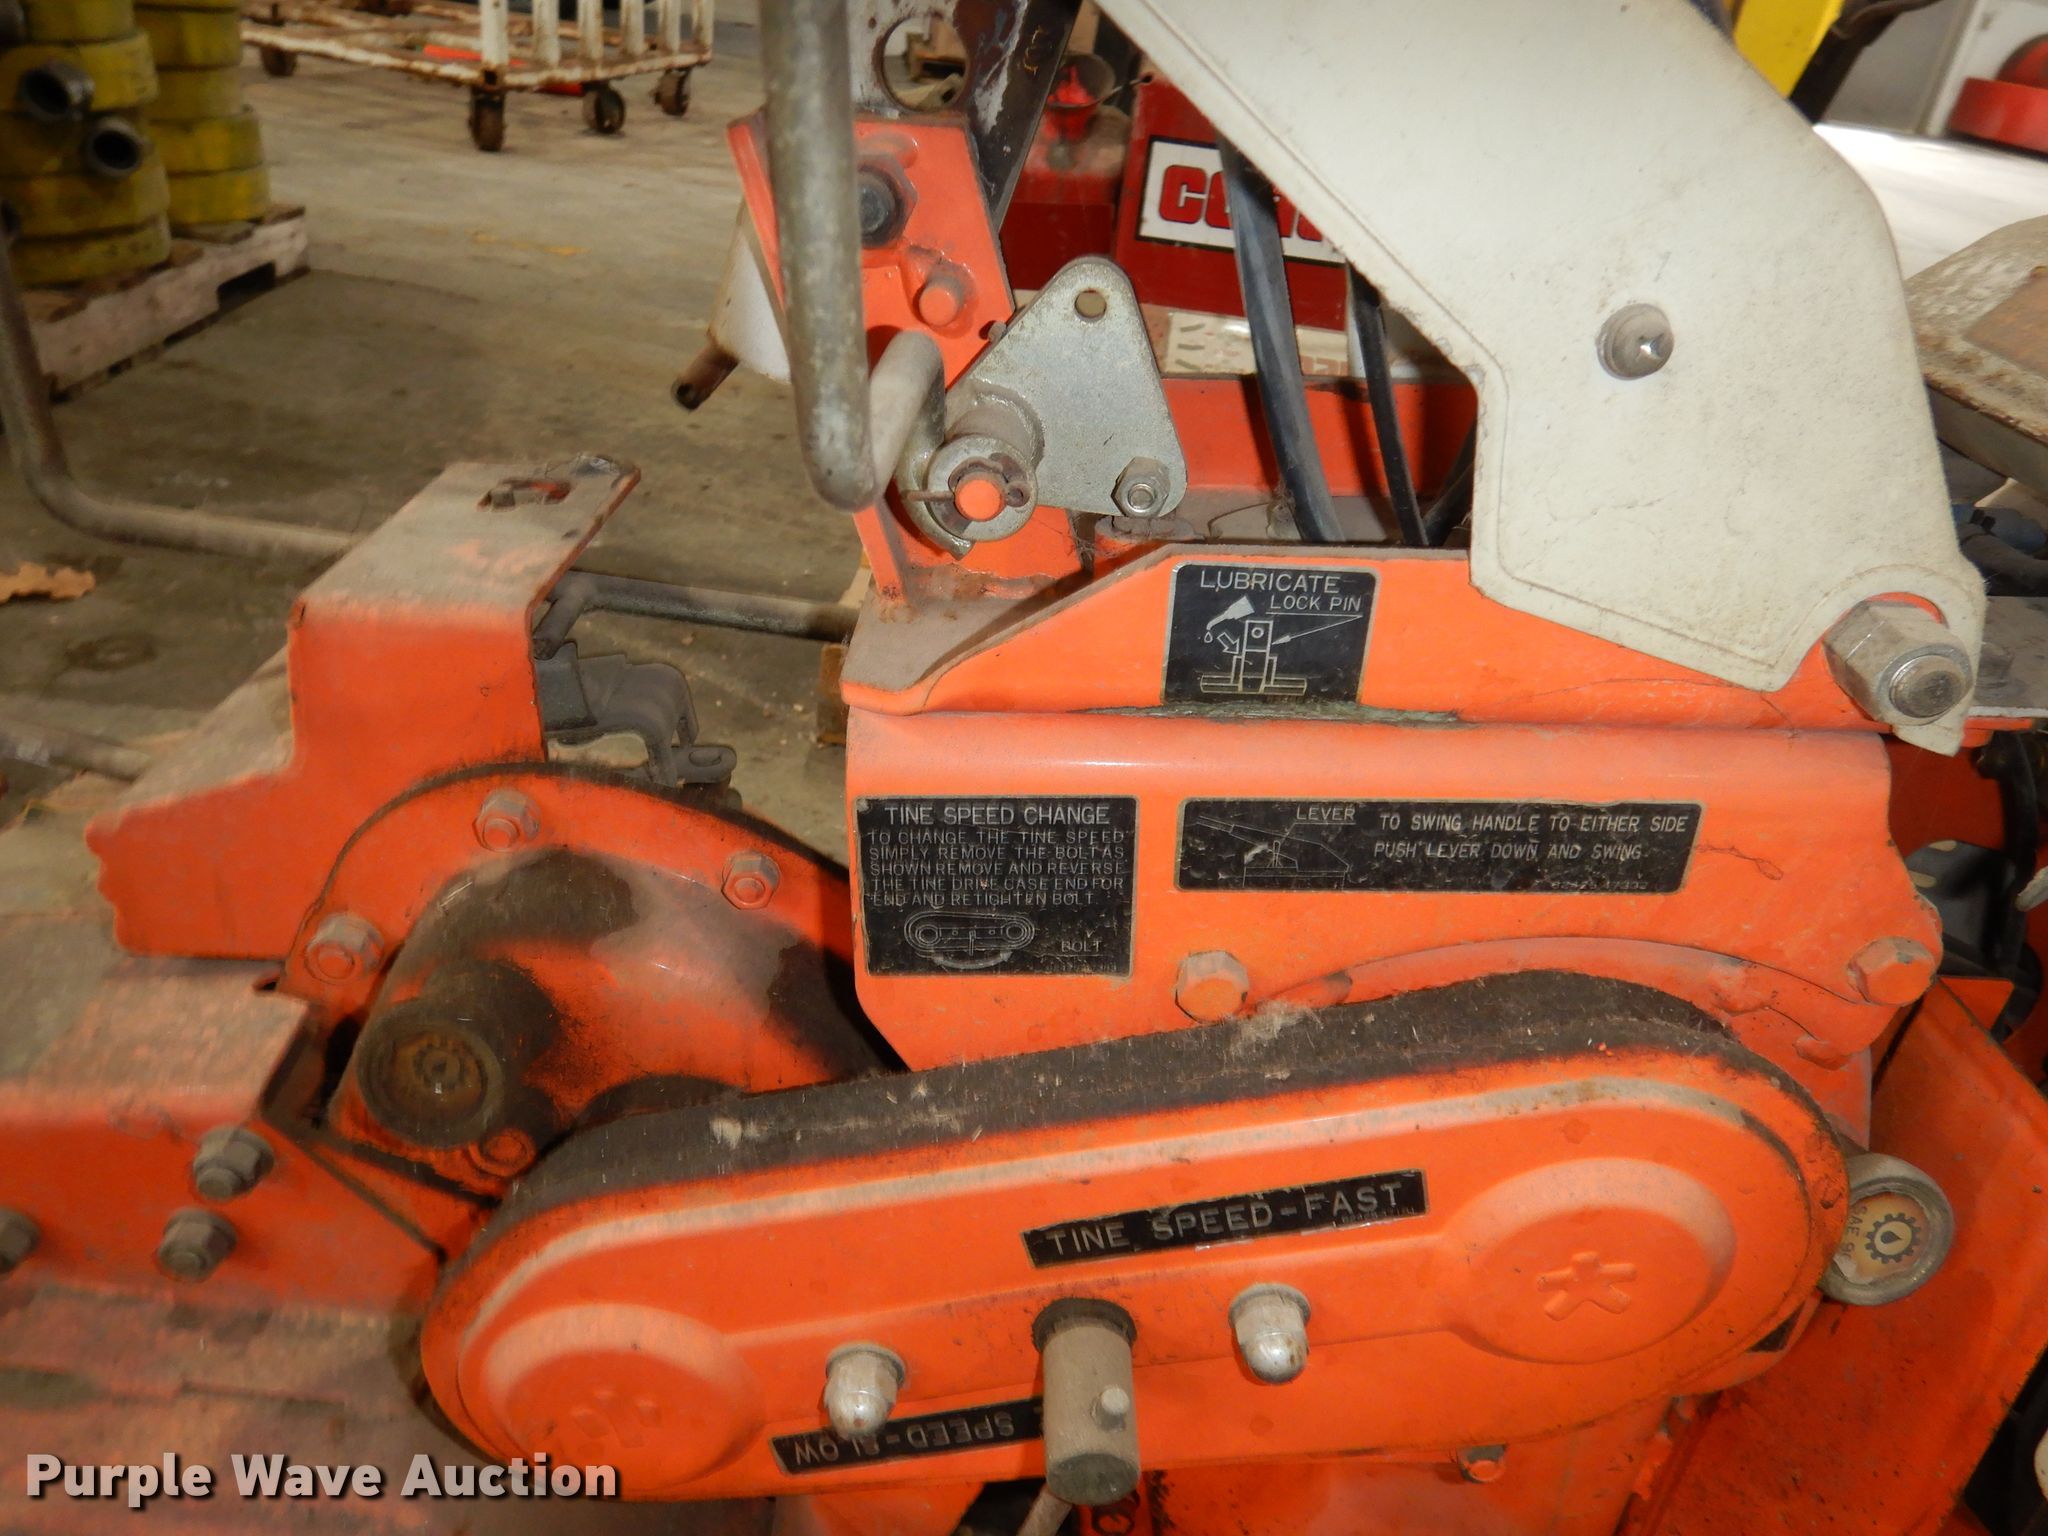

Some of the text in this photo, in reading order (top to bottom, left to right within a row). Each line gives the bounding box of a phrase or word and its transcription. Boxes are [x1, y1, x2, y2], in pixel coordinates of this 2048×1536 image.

[1200, 569, 1341, 594] LUBRICATE
[1270, 595, 1362, 612] LOCK PIN
[885, 803, 1110, 825] TINE SPEED CHANGE
[1296, 805, 1356, 822] LEVER
[1380, 815, 1687, 833] TO SWING HANDLE TO EITHER SIDE
[870, 830, 1124, 845] TO CHANGE THE TINE SPEED
[869, 847, 1124, 861] SIMPLY REMOVE THE BOLT AS
[1373, 841, 1642, 861] PUSH LEVER DOWN AND SWING
[870, 862, 1124, 876] SHOWN REMOVE AND REVERSE
[871, 877, 1123, 892] THE TINE DRIVE CASE END FOR
[912, 892, 945, 907] AND
[951, 893, 1047, 907] RETIGHTEN
[1061, 940, 1103, 954] BOLT
[1847, 1204, 1867, 1237] SAE
[1046, 1222, 1131, 1255] TINE
